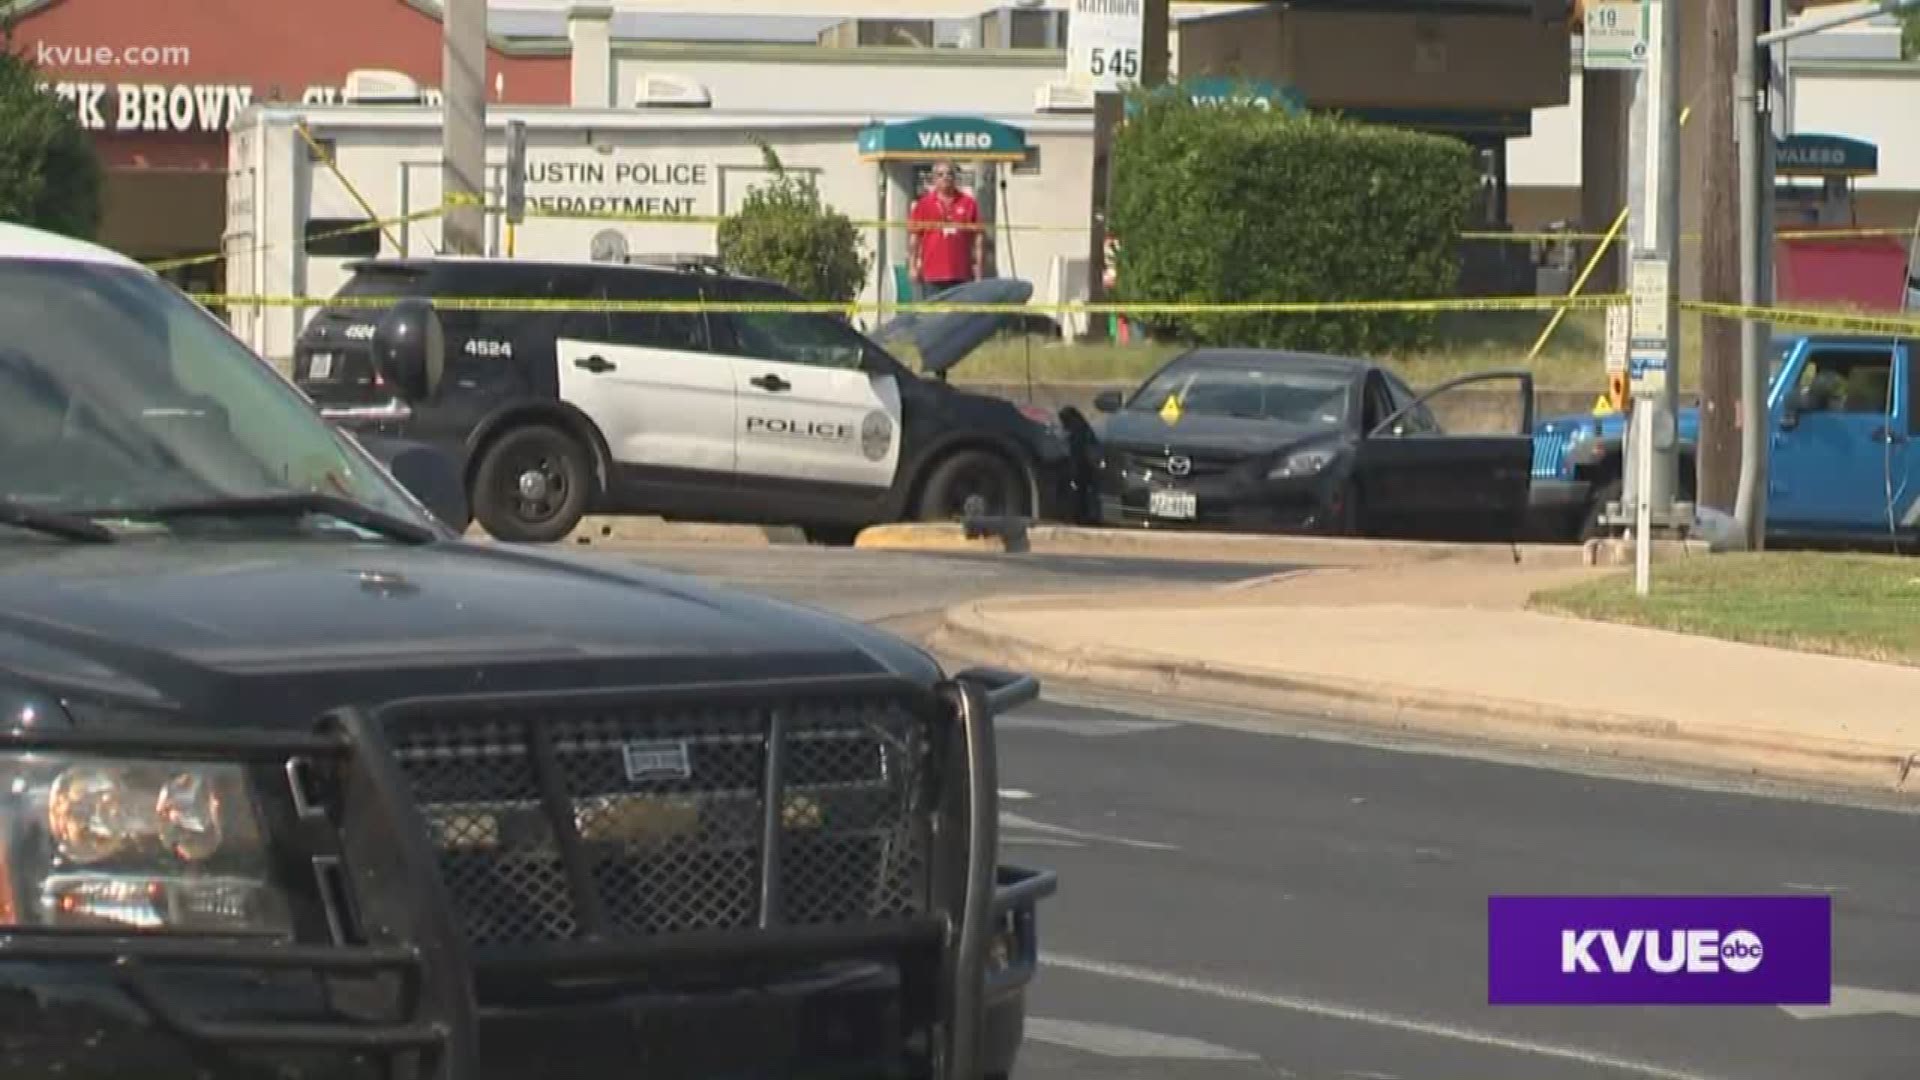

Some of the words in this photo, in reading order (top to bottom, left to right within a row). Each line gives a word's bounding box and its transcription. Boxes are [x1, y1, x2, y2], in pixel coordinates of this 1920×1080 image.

[116, 83, 253, 131] BROWN
[918, 131, 992, 148] VALERO
[1776, 148, 1845, 164] VALERO
[524, 162, 604, 184] USTIN
[615, 163, 708, 184] POLICE
[463, 339, 514, 358] 4524
[746, 416, 855, 439] POLICE
